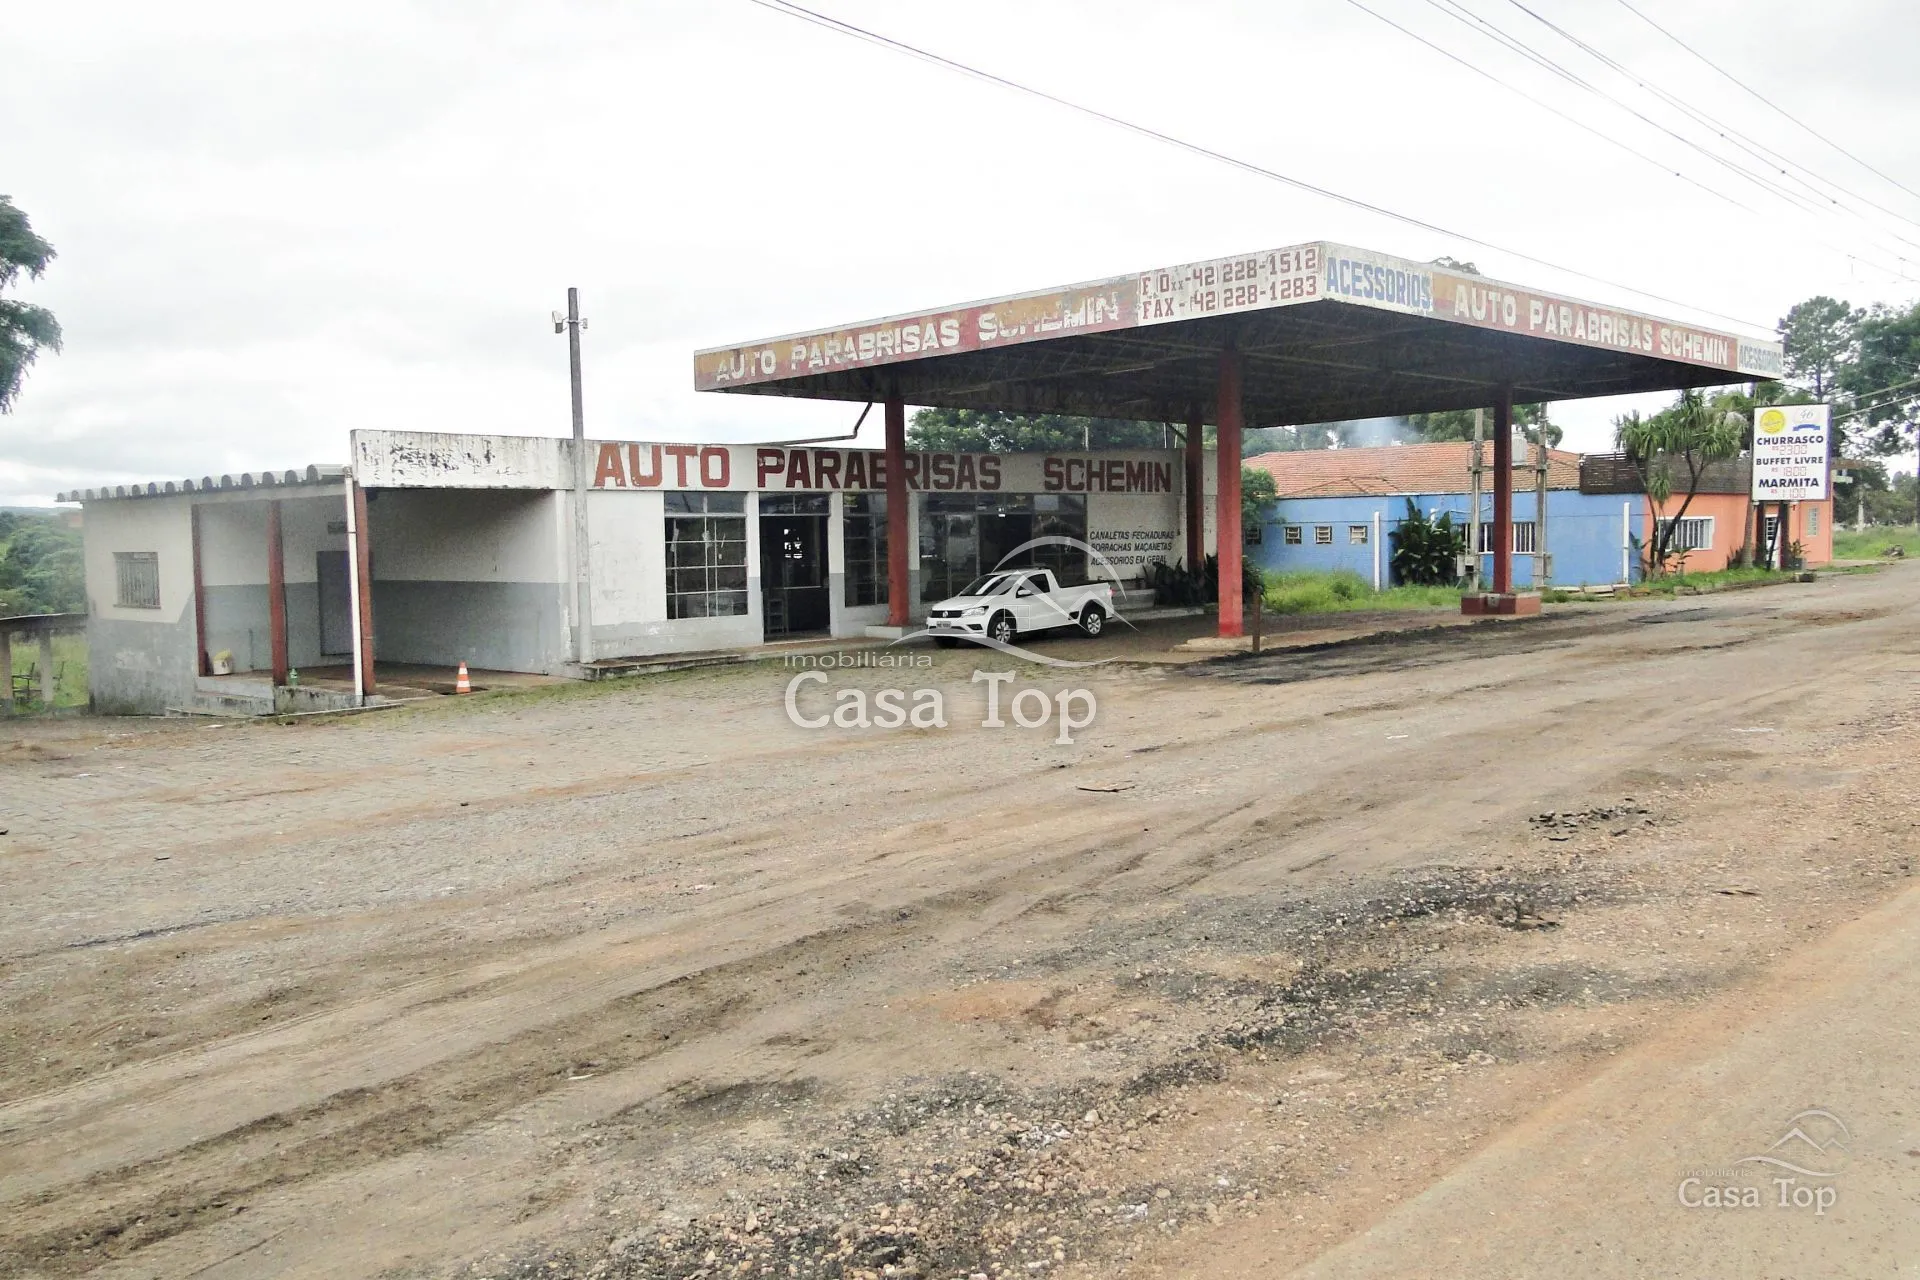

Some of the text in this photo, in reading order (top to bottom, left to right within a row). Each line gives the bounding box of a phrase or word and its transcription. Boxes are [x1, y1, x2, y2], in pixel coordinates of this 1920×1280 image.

[1326, 256, 1431, 310] ACESSORIOS
[1143, 296, 1174, 320] FAX
[1454, 284, 1728, 365] AUTO PARABRISAS SCHEMIN
[715, 349, 777, 382] AUTO
[790, 319, 961, 370] PARABRISAS
[1756, 435, 1824, 445] CHURRASCO
[594, 442, 1172, 493] AUTO PARABRISAS SCHEMIN
[1756, 456, 1824, 466] BUFFET LIVRE
[1758, 478, 1819, 488] MARMITA
[1090, 530, 1174, 540] CANALETAS FECHADURAS
[1136, 556, 1145, 564] EM
